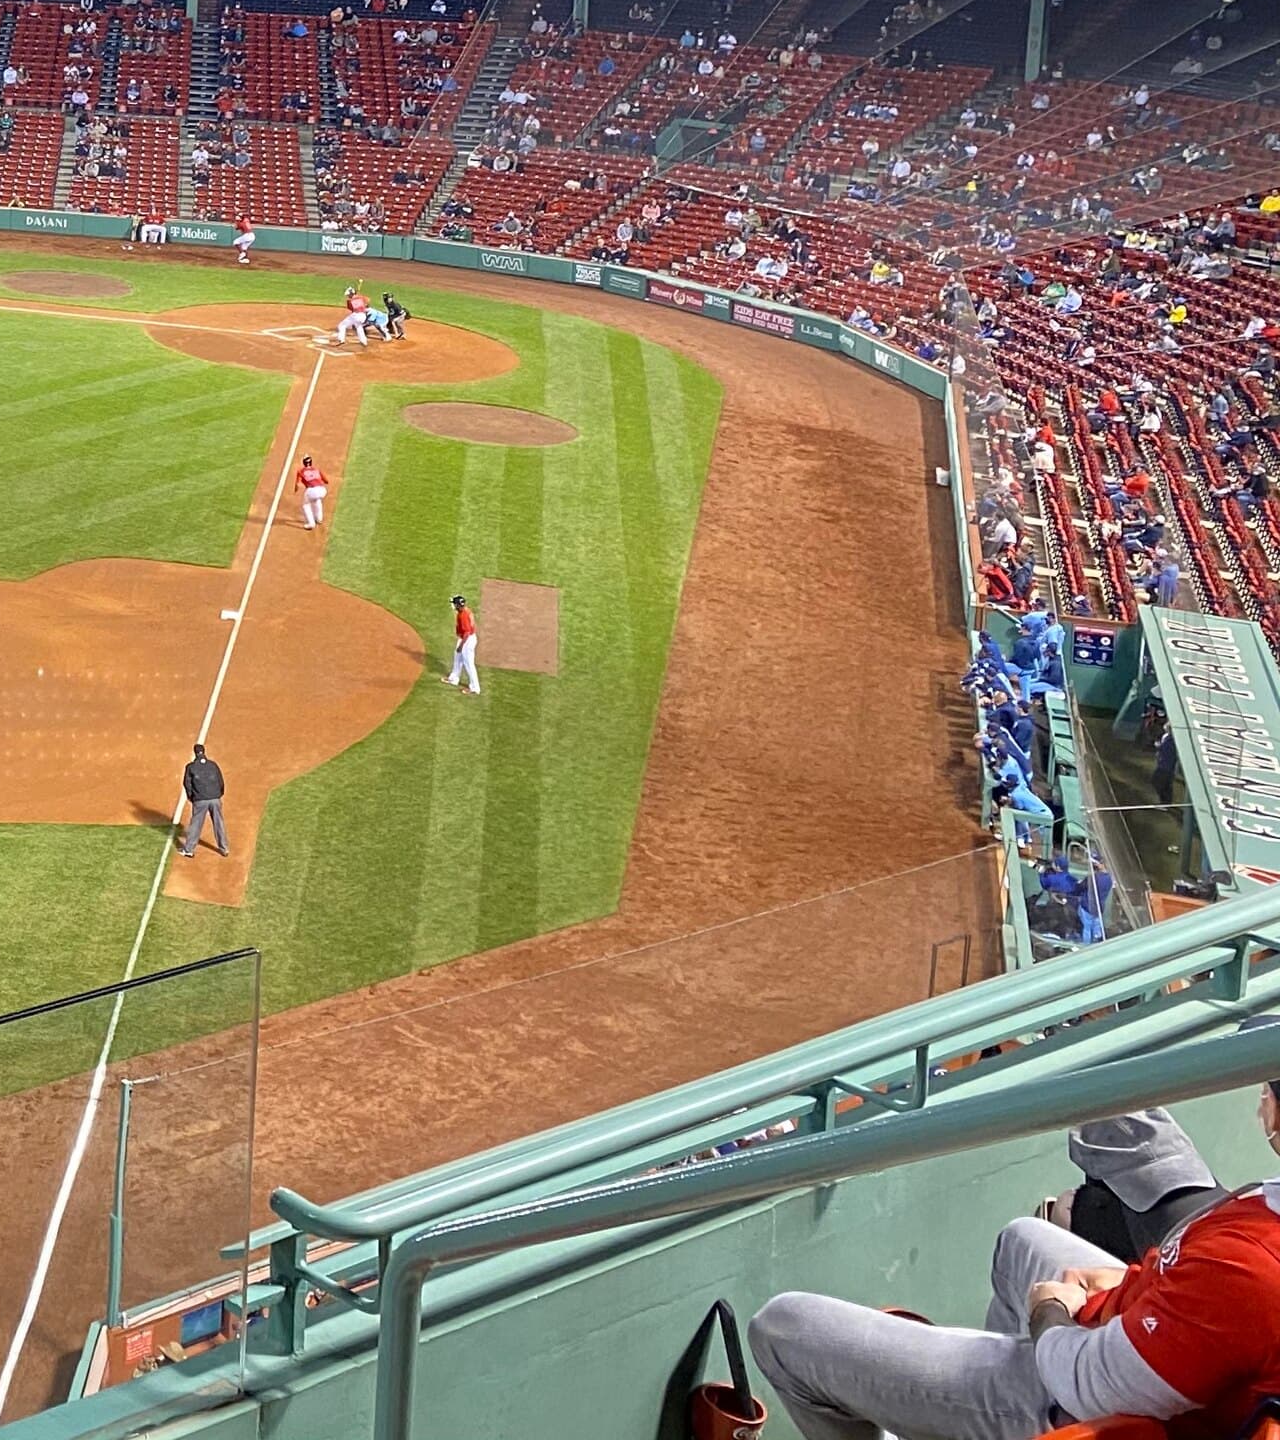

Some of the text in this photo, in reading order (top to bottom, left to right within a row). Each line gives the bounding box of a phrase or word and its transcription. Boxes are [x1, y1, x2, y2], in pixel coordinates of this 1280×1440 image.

[25, 215, 68, 228] DASANI
[182, 227, 217, 241] Mobile
[481, 253, 524, 272] WM
[733, 303, 754, 316] KIDS
[755, 309, 771, 322] EAT
[772, 314, 795, 327] FREE
[1162, 616, 1280, 842] FENWAY PARK
